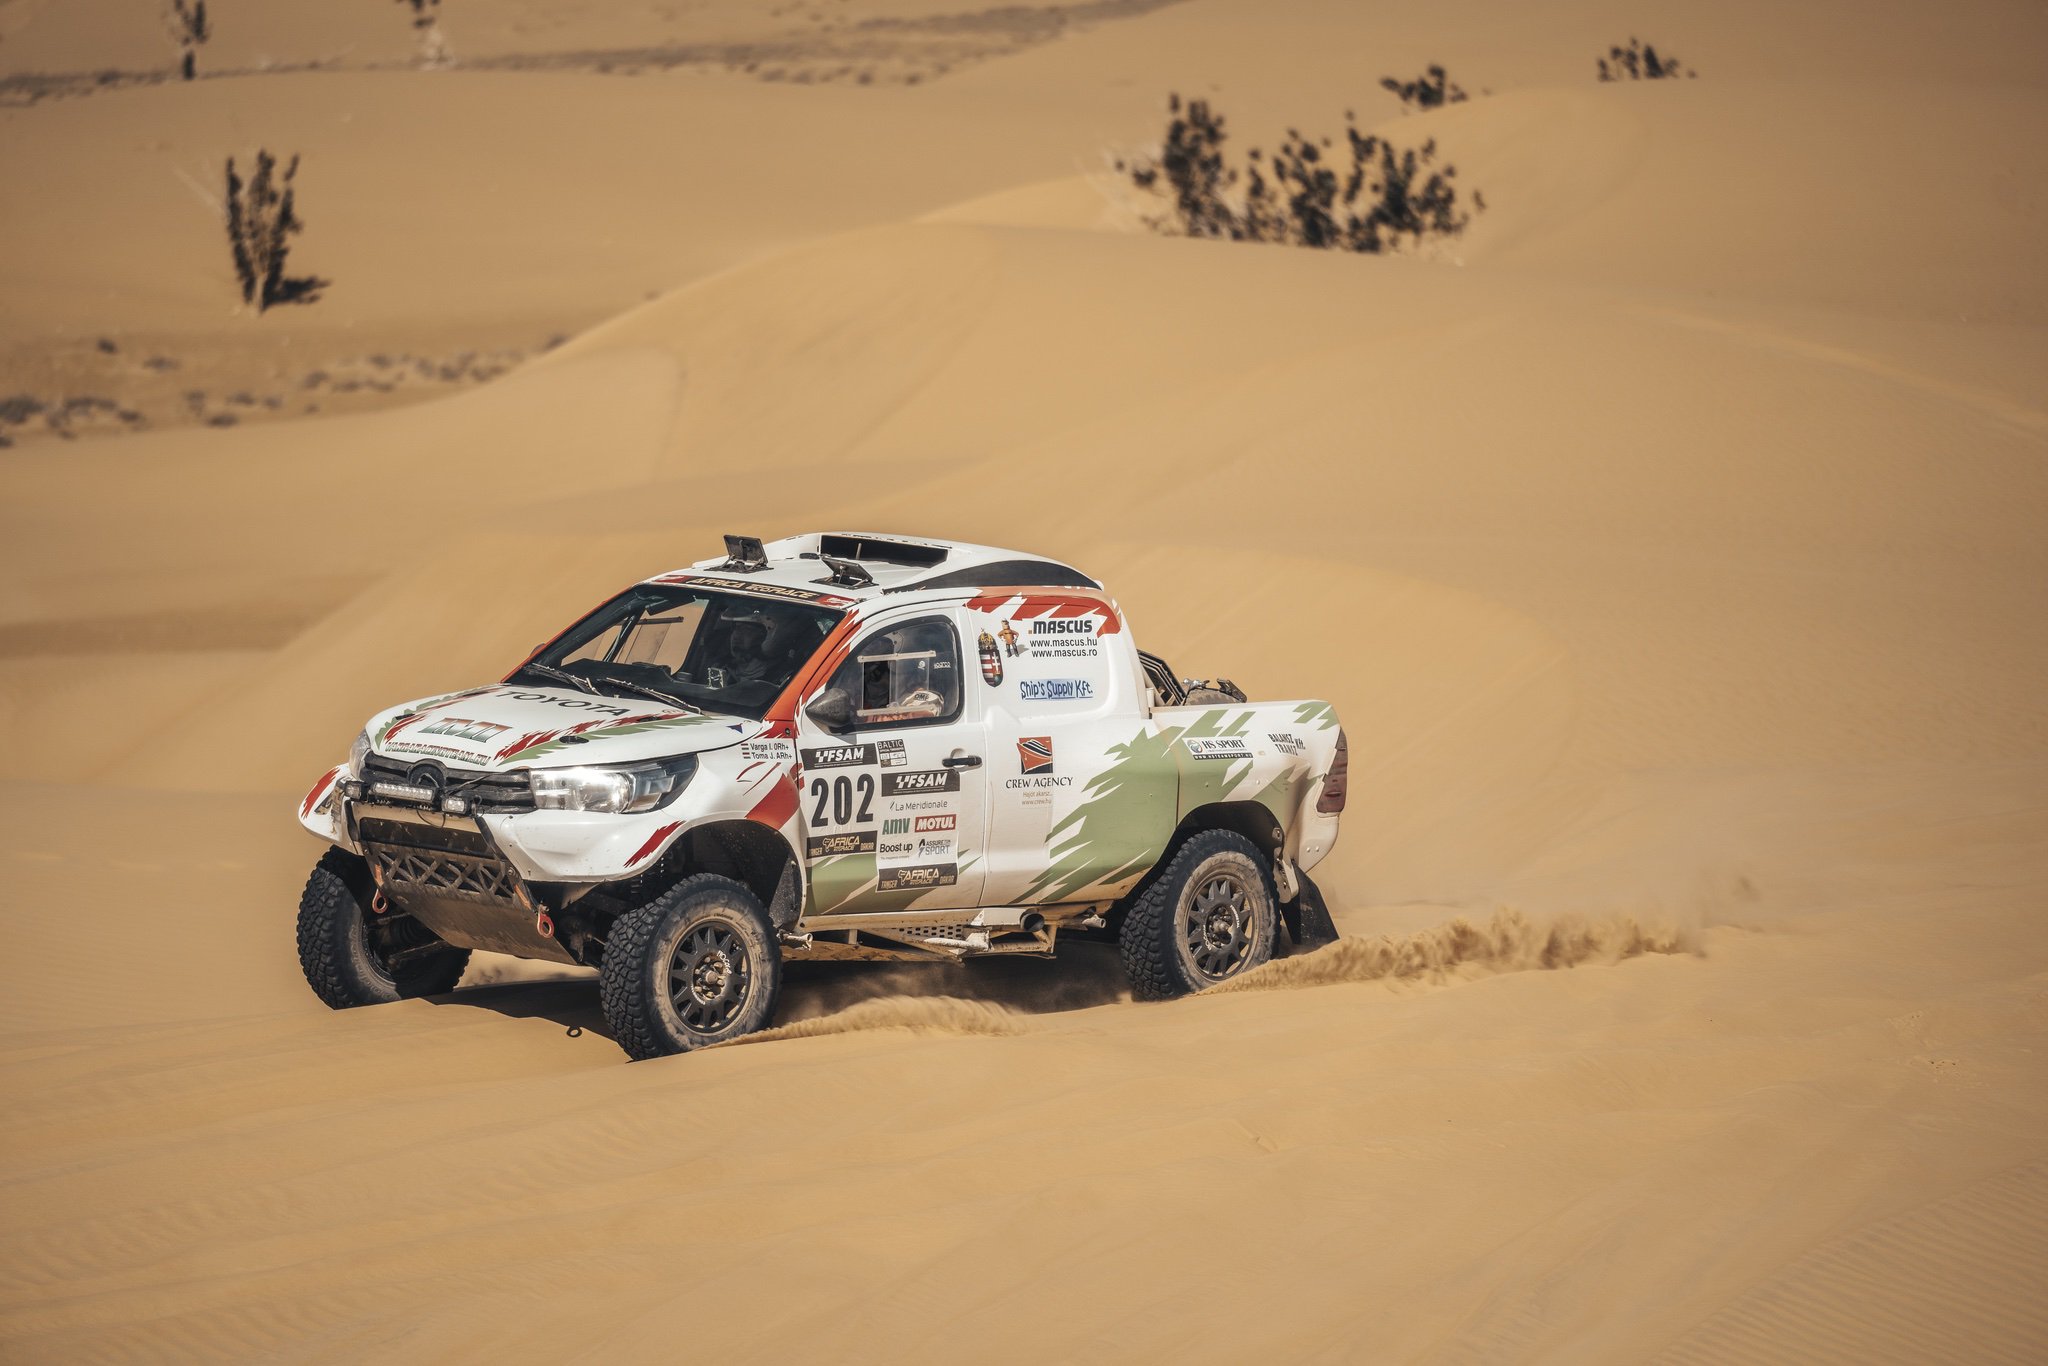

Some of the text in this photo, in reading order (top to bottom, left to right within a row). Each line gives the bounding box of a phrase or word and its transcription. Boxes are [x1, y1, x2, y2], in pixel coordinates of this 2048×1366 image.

[686, 578, 745, 589] AFRICA
[1030, 637, 1097, 647] www.mascus.hu
[1032, 649, 1098, 657] www.mascus.ro
[1020, 680, 1093, 700] Ship's Supply Kft.
[496, 691, 631, 717] TOYOTA
[750, 743, 768, 752] Varga
[878, 740, 904, 749] BALTIC
[1201, 740, 1246, 749] HS SPORT
[1005, 777, 1073, 789] CREW AGENCY
[811, 773, 875, 828] 202
[895, 803, 904, 811] La
[916, 816, 954, 831] MOTUL
[828, 836, 860, 848] AFRICA
[880, 843, 913, 853] Boost up
[925, 845, 950, 855] SPORT
[904, 868, 939, 881] AFRICA
